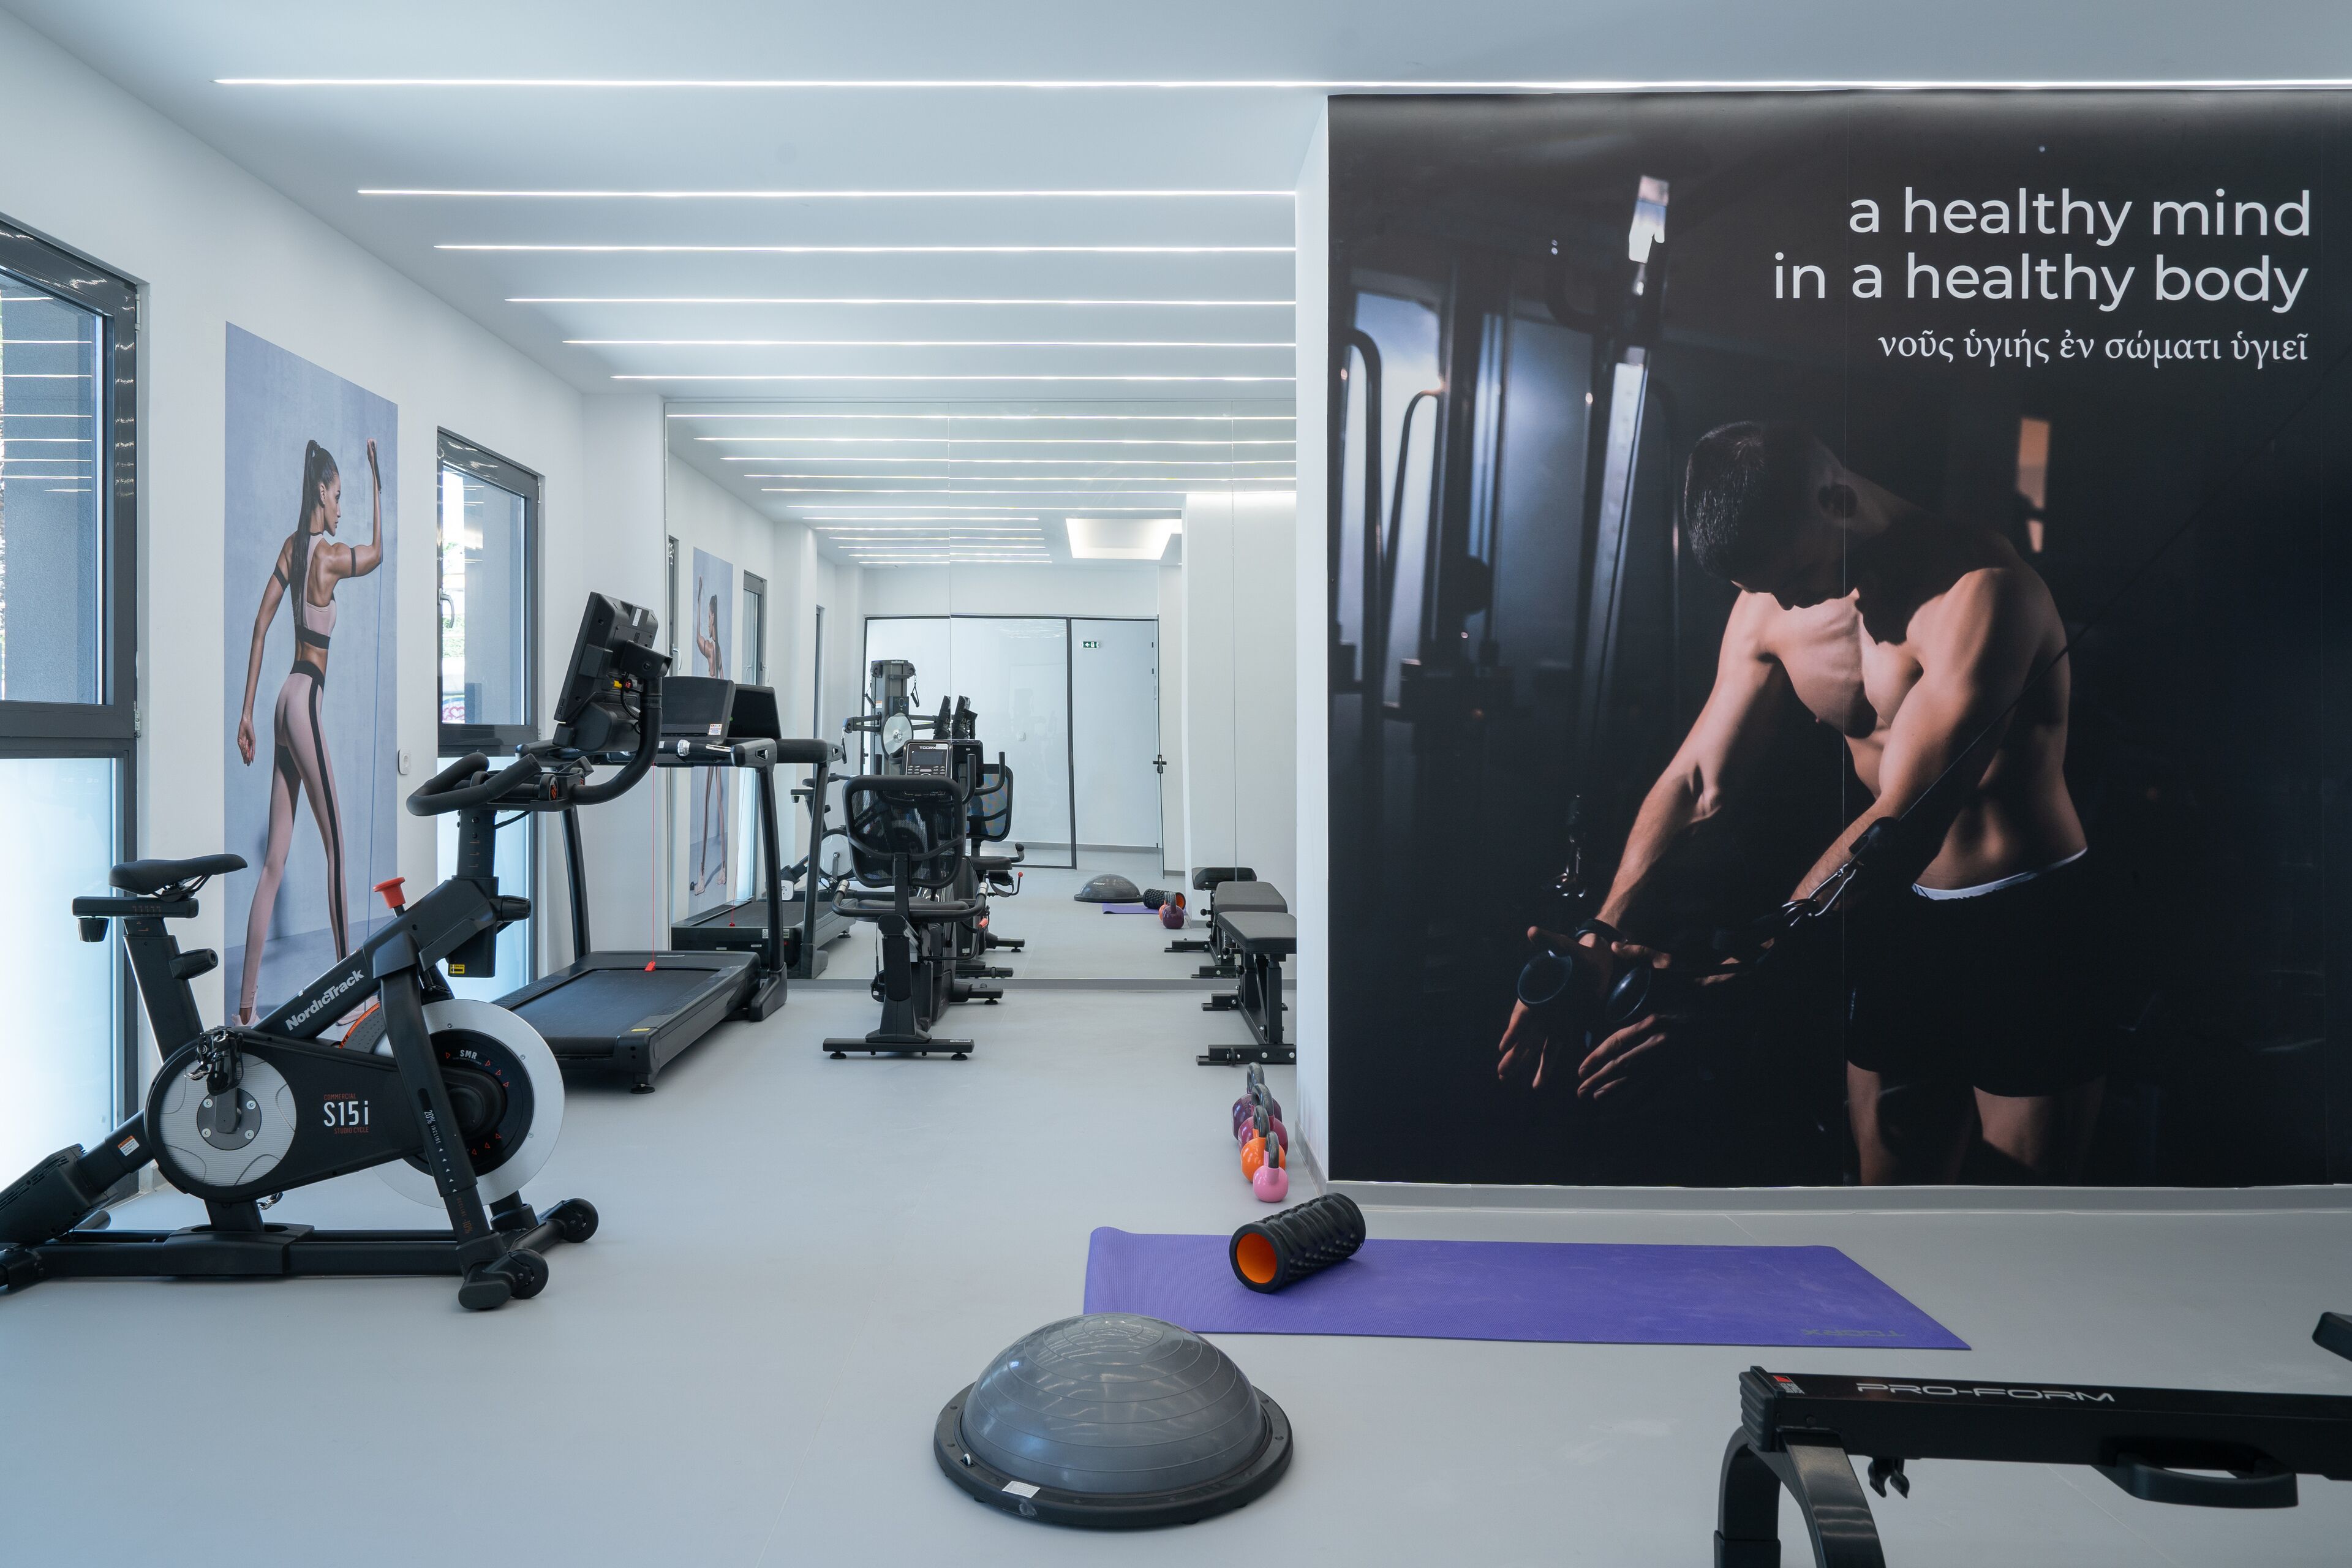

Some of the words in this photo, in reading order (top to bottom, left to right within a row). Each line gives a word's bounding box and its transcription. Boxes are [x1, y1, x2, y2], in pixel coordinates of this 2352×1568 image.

[1849, 199, 1879, 233] a
[1905, 186, 2133, 247] healthy
[2153, 188, 2310, 236] mind
[1774, 252, 1825, 299] in
[1852, 264, 1882, 298] a
[1907, 252, 2135, 312] healthy
[2156, 254, 2309, 314] body
[1877, 330, 1954, 363] νοῦς
[1963, 328, 2049, 368] ὑγιής
[2060, 329, 2095, 358] ἐν
[2105, 330, 2222, 369] σώματι
[285, 970, 365, 1031] NordicTrack
[459, 1049, 478, 1060] SMR
[323, 1100, 369, 1127] S15i
[424, 1109, 436, 1124] 20%
[431, 1125, 442, 1144] INCLINE
[1855, 1382, 2116, 1402] PRO-FORM
